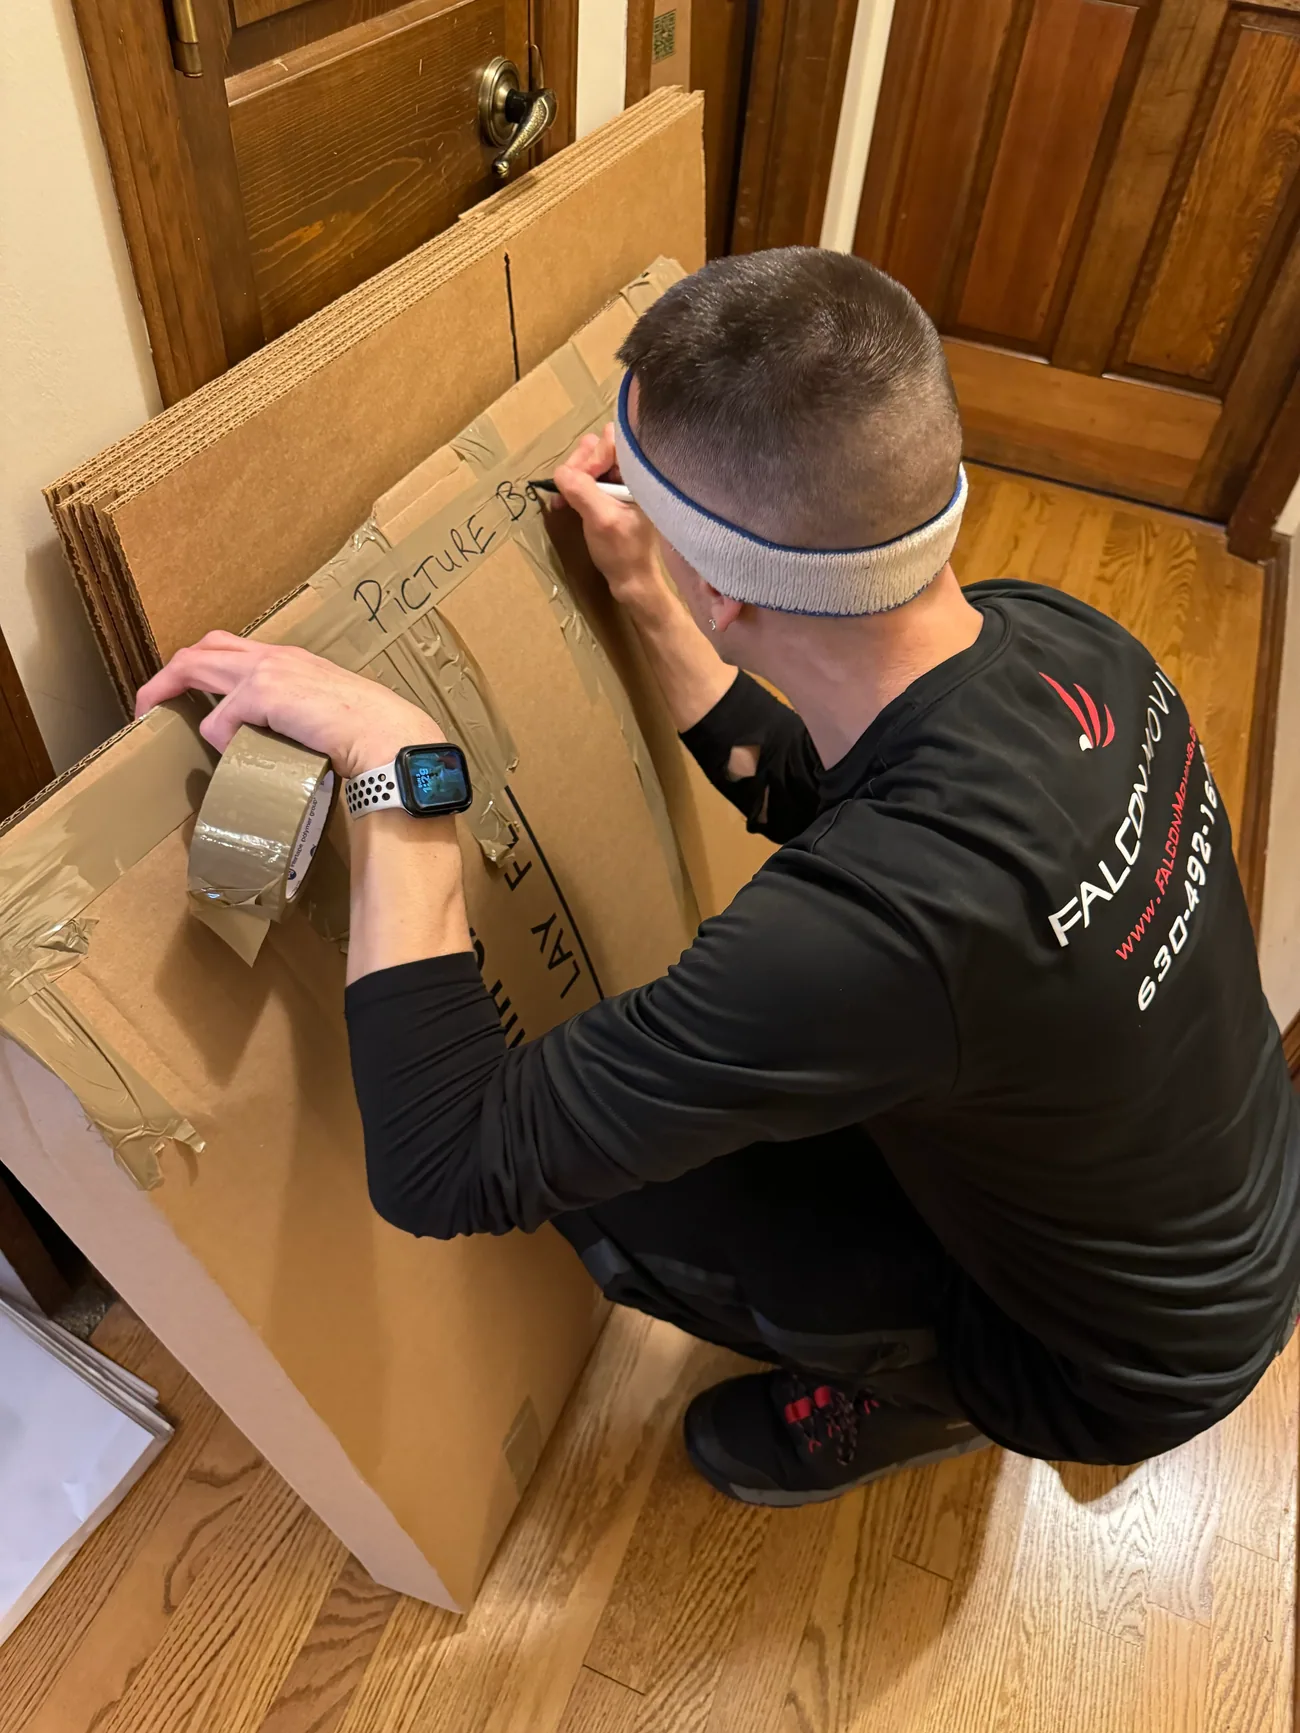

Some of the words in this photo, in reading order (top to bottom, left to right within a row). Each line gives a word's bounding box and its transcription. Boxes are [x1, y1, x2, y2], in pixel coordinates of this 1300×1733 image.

[300, 817, 313, 843] polymer
[503, 823, 533, 892] FL
[1137, 743, 1219, 1012] 630-492-16
[530, 911, 581, 999] LAY
